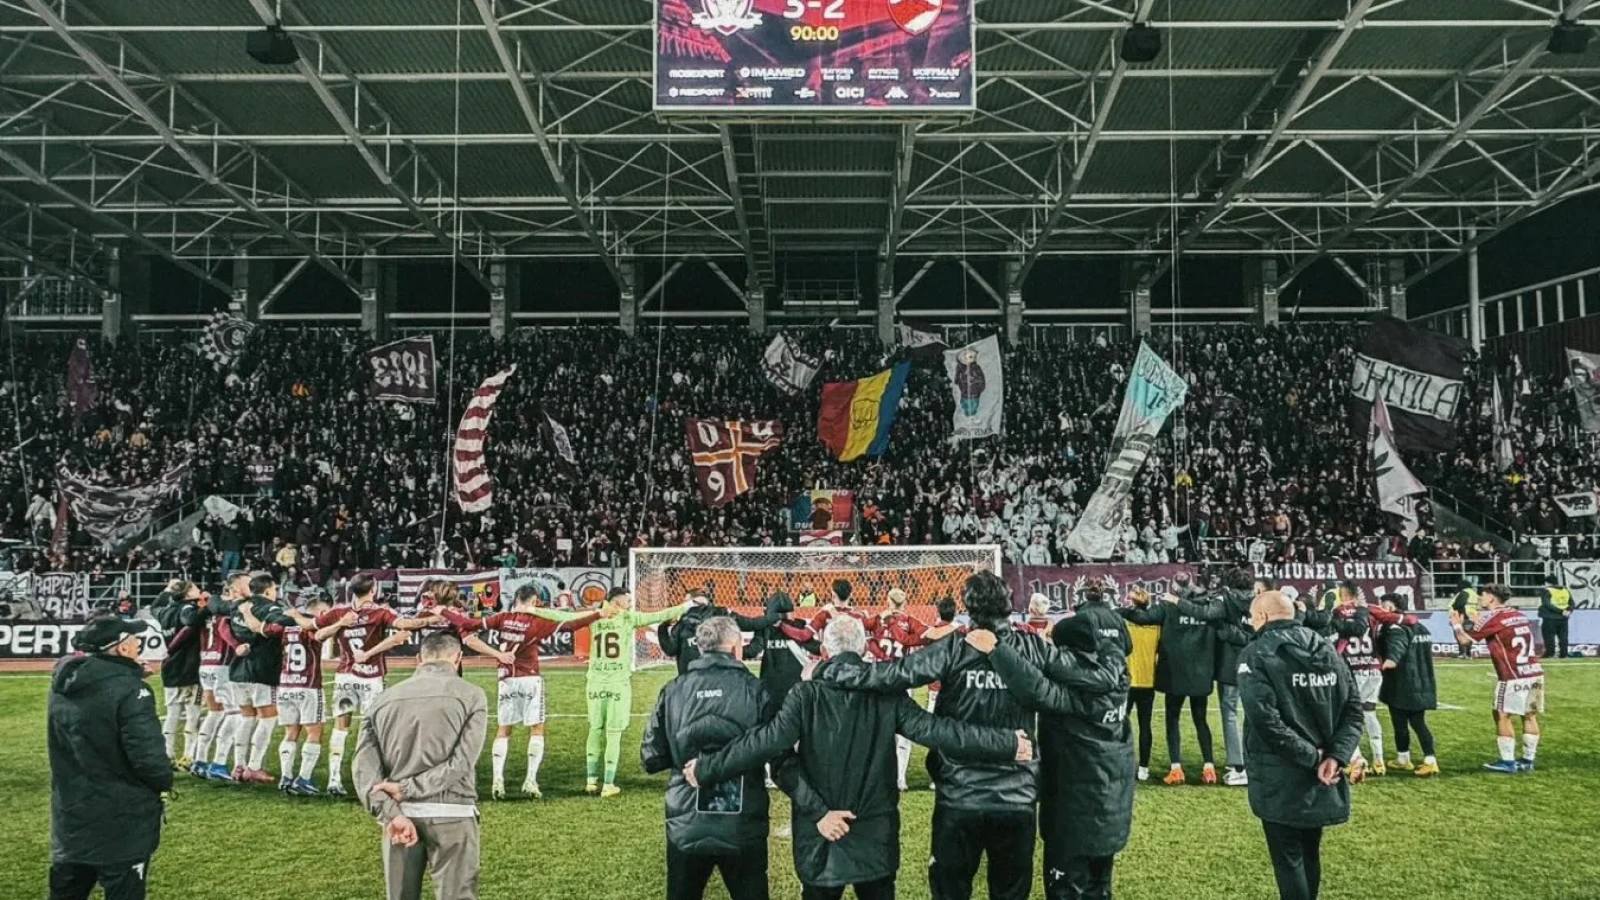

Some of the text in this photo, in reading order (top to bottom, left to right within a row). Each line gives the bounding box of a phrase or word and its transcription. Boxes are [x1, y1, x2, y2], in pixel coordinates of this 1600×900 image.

[790, 25, 839, 41] 90:00
[1351, 358, 1461, 419] CHITILA
[1253, 561, 1417, 580] LEGIUNEA CHITILA
[593, 631, 621, 659] 16
[966, 670, 985, 689] FC
[1292, 672, 1308, 688] FC
[1102, 709, 1118, 724] FC
